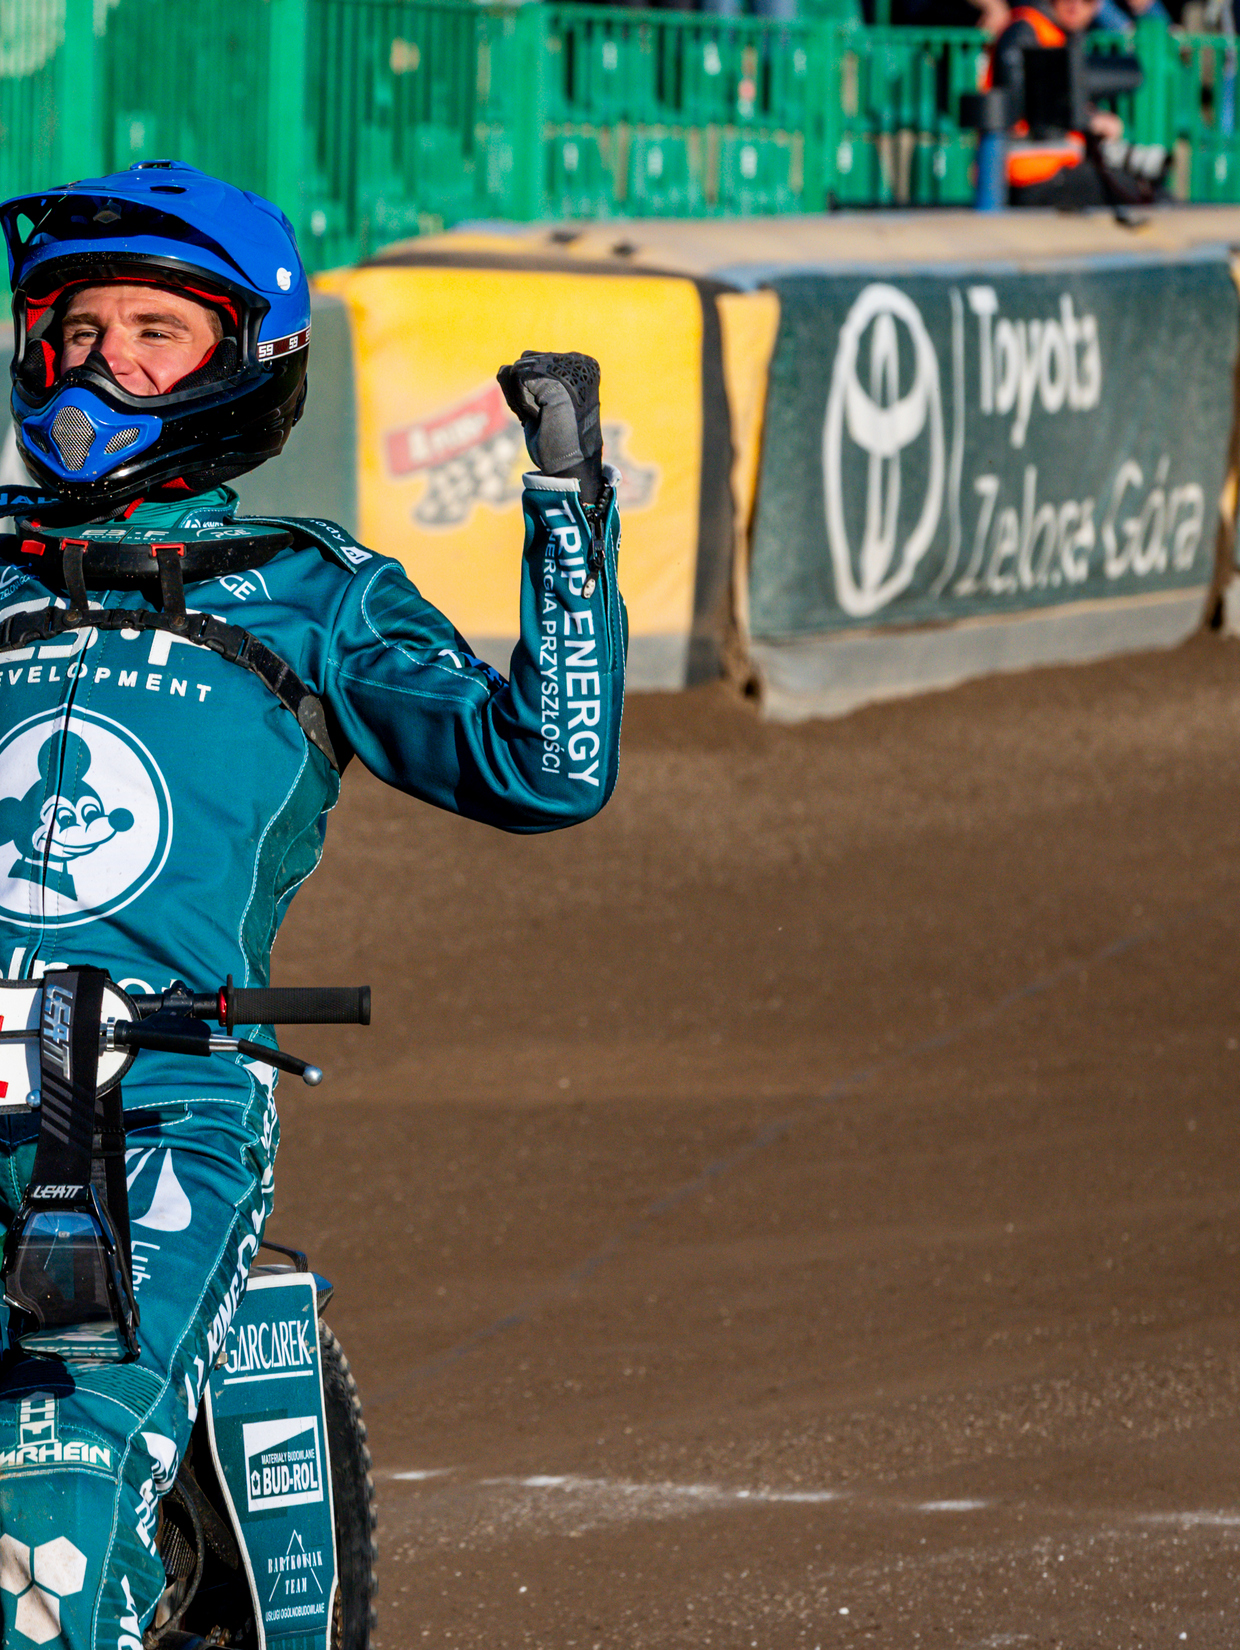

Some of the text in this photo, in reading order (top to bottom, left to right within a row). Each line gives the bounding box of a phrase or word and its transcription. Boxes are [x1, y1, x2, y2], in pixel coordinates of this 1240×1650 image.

[258, 343, 274, 358] 59
[966, 285, 1102, 449] Toyota
[539, 515, 565, 774] NERGIA PRZYSZŁOŚCI
[563, 609, 601, 787] ENERGY
[33, 1185, 84, 1199] LEATT
[222, 1319, 313, 1374] GARCAREK
[262, 1461, 318, 1496] BUD-ROL
[267, 1550, 323, 1574] BARTKOWIAK
[285, 1577, 307, 1595] TEAM
